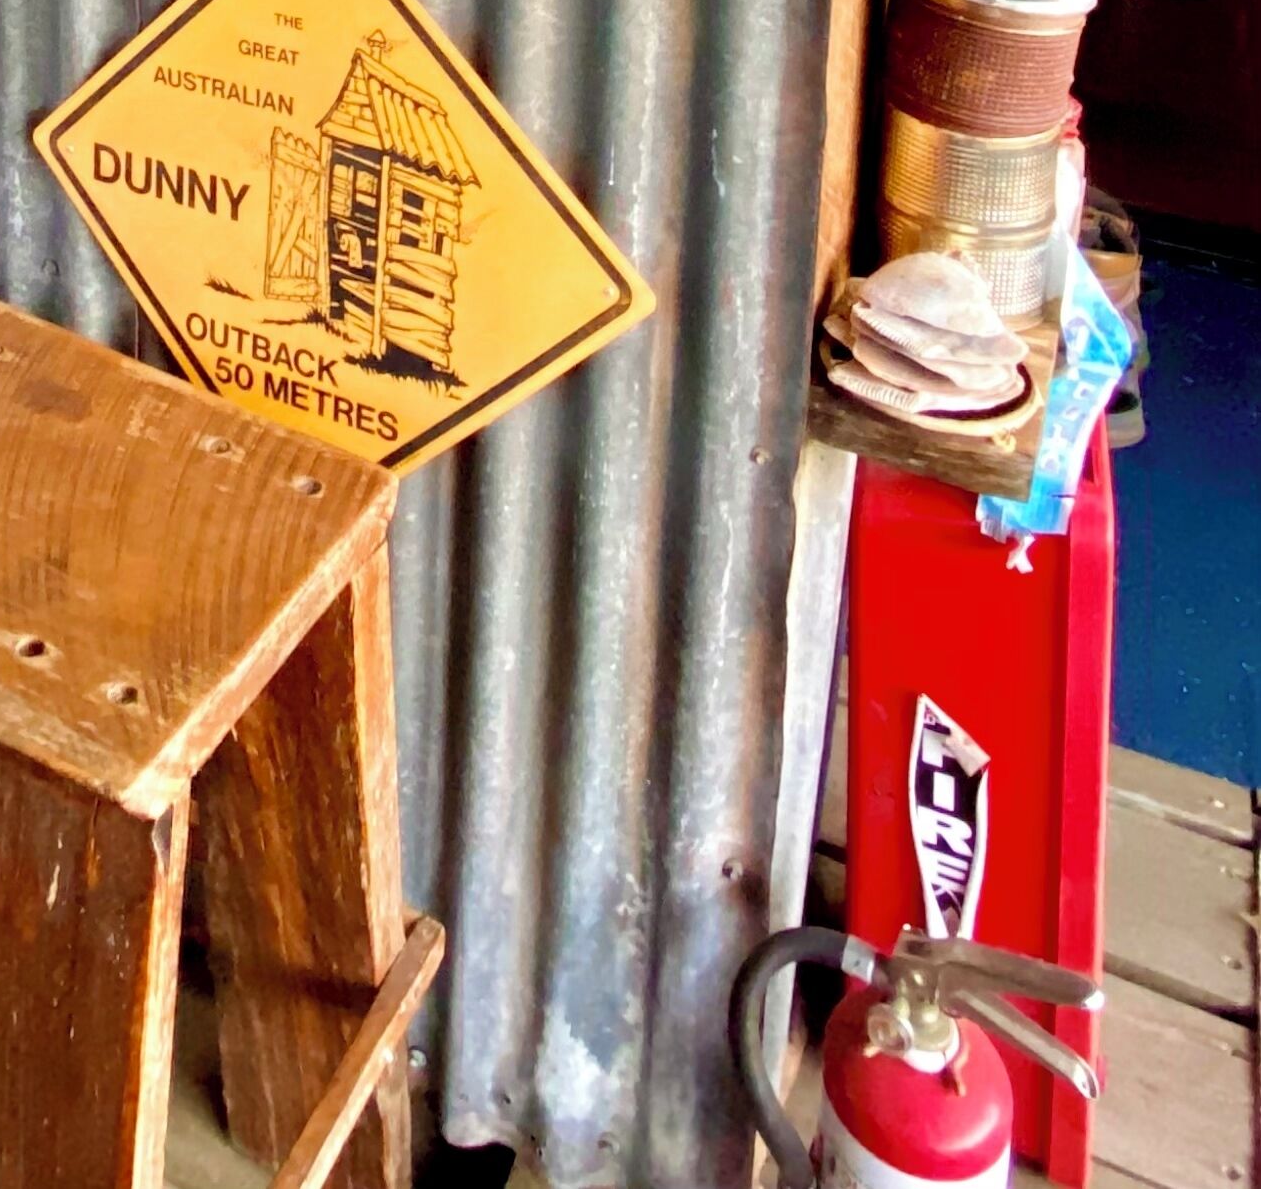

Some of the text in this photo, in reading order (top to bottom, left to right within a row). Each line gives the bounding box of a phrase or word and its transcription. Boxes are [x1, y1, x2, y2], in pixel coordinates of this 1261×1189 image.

[274, 13, 304, 31] THE
[238, 40, 299, 67] GREAT
[154, 66, 294, 116] AUSTRALIAN
[93, 143, 250, 222] DUNNY
[186, 312, 338, 387] OUTBACK
[215, 356, 399, 442] 50 METRES
